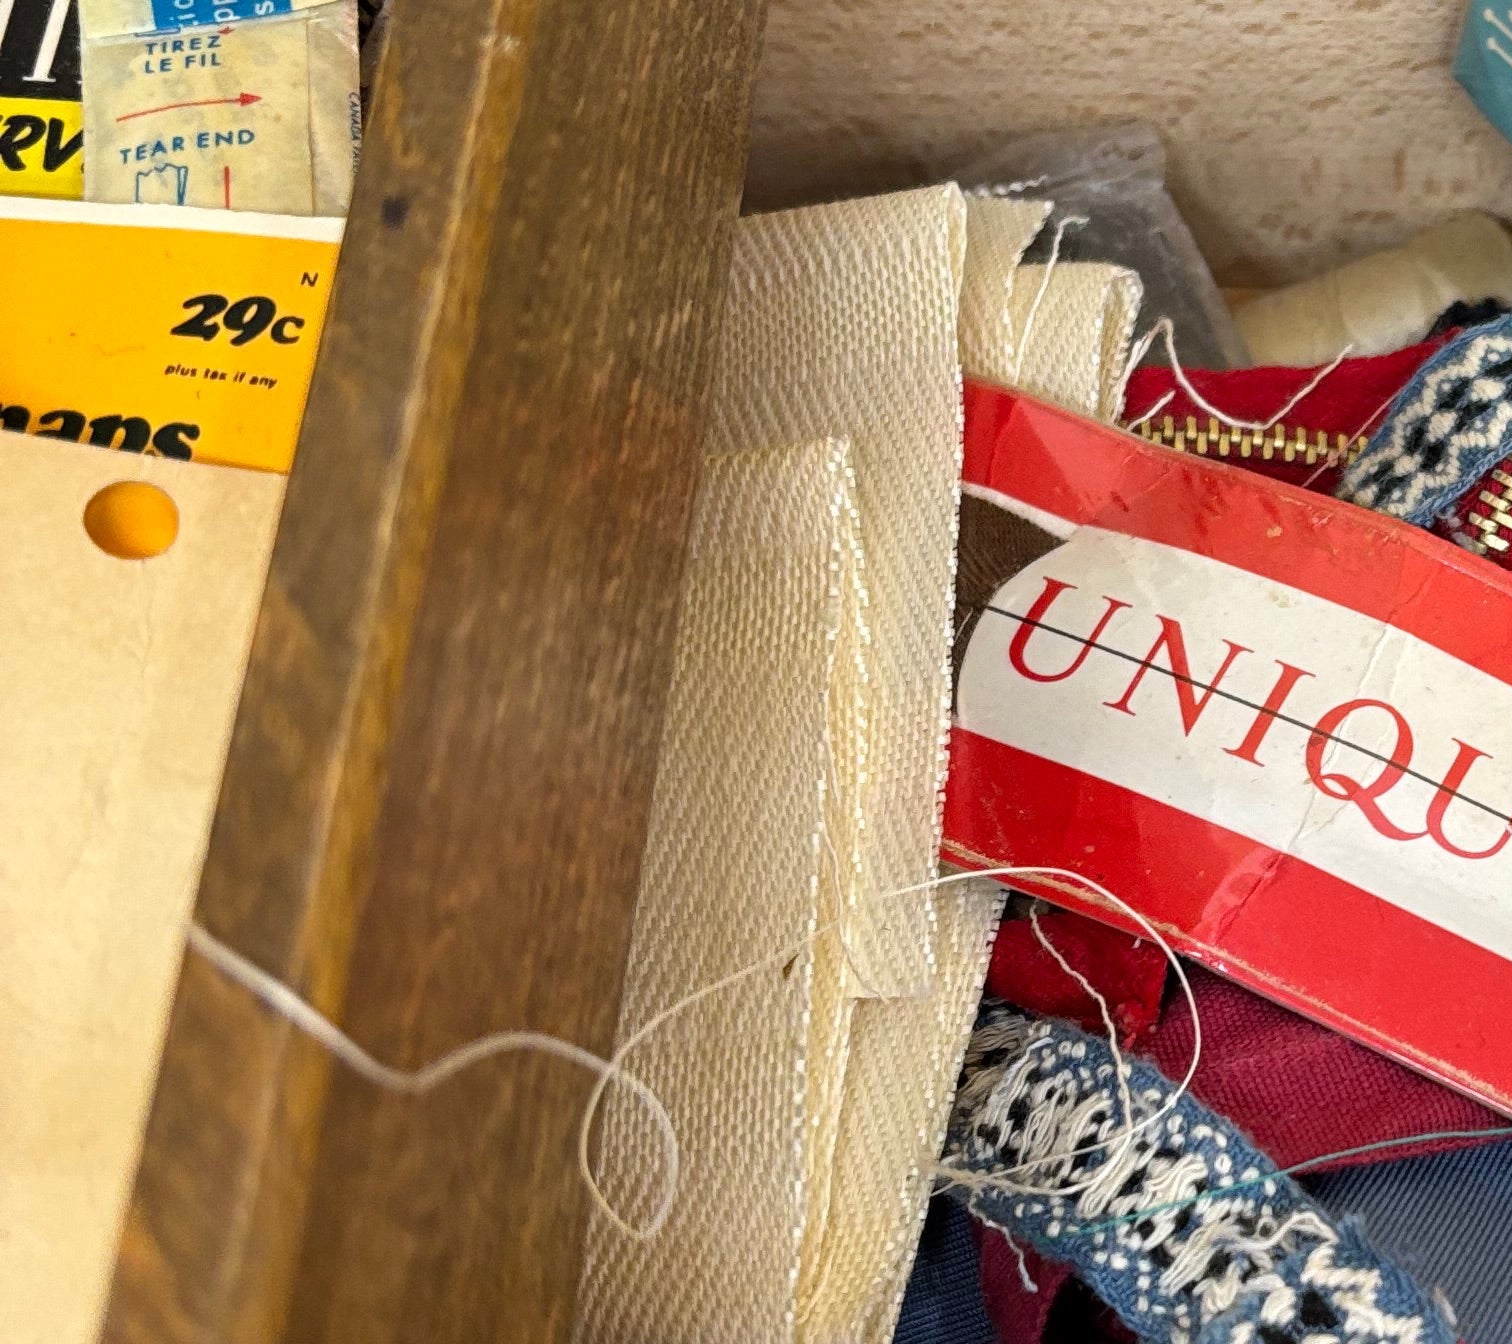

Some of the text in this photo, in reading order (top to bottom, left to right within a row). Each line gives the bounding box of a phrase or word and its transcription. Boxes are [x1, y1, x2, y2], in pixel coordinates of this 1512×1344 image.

[145, 34, 222, 56] TIREZ
[144, 52, 222, 74] LE FIL
[120, 128, 256, 165] TEAR END
[300, 271, 319, 288] N
[164, 362, 279, 391] plus tax if any
